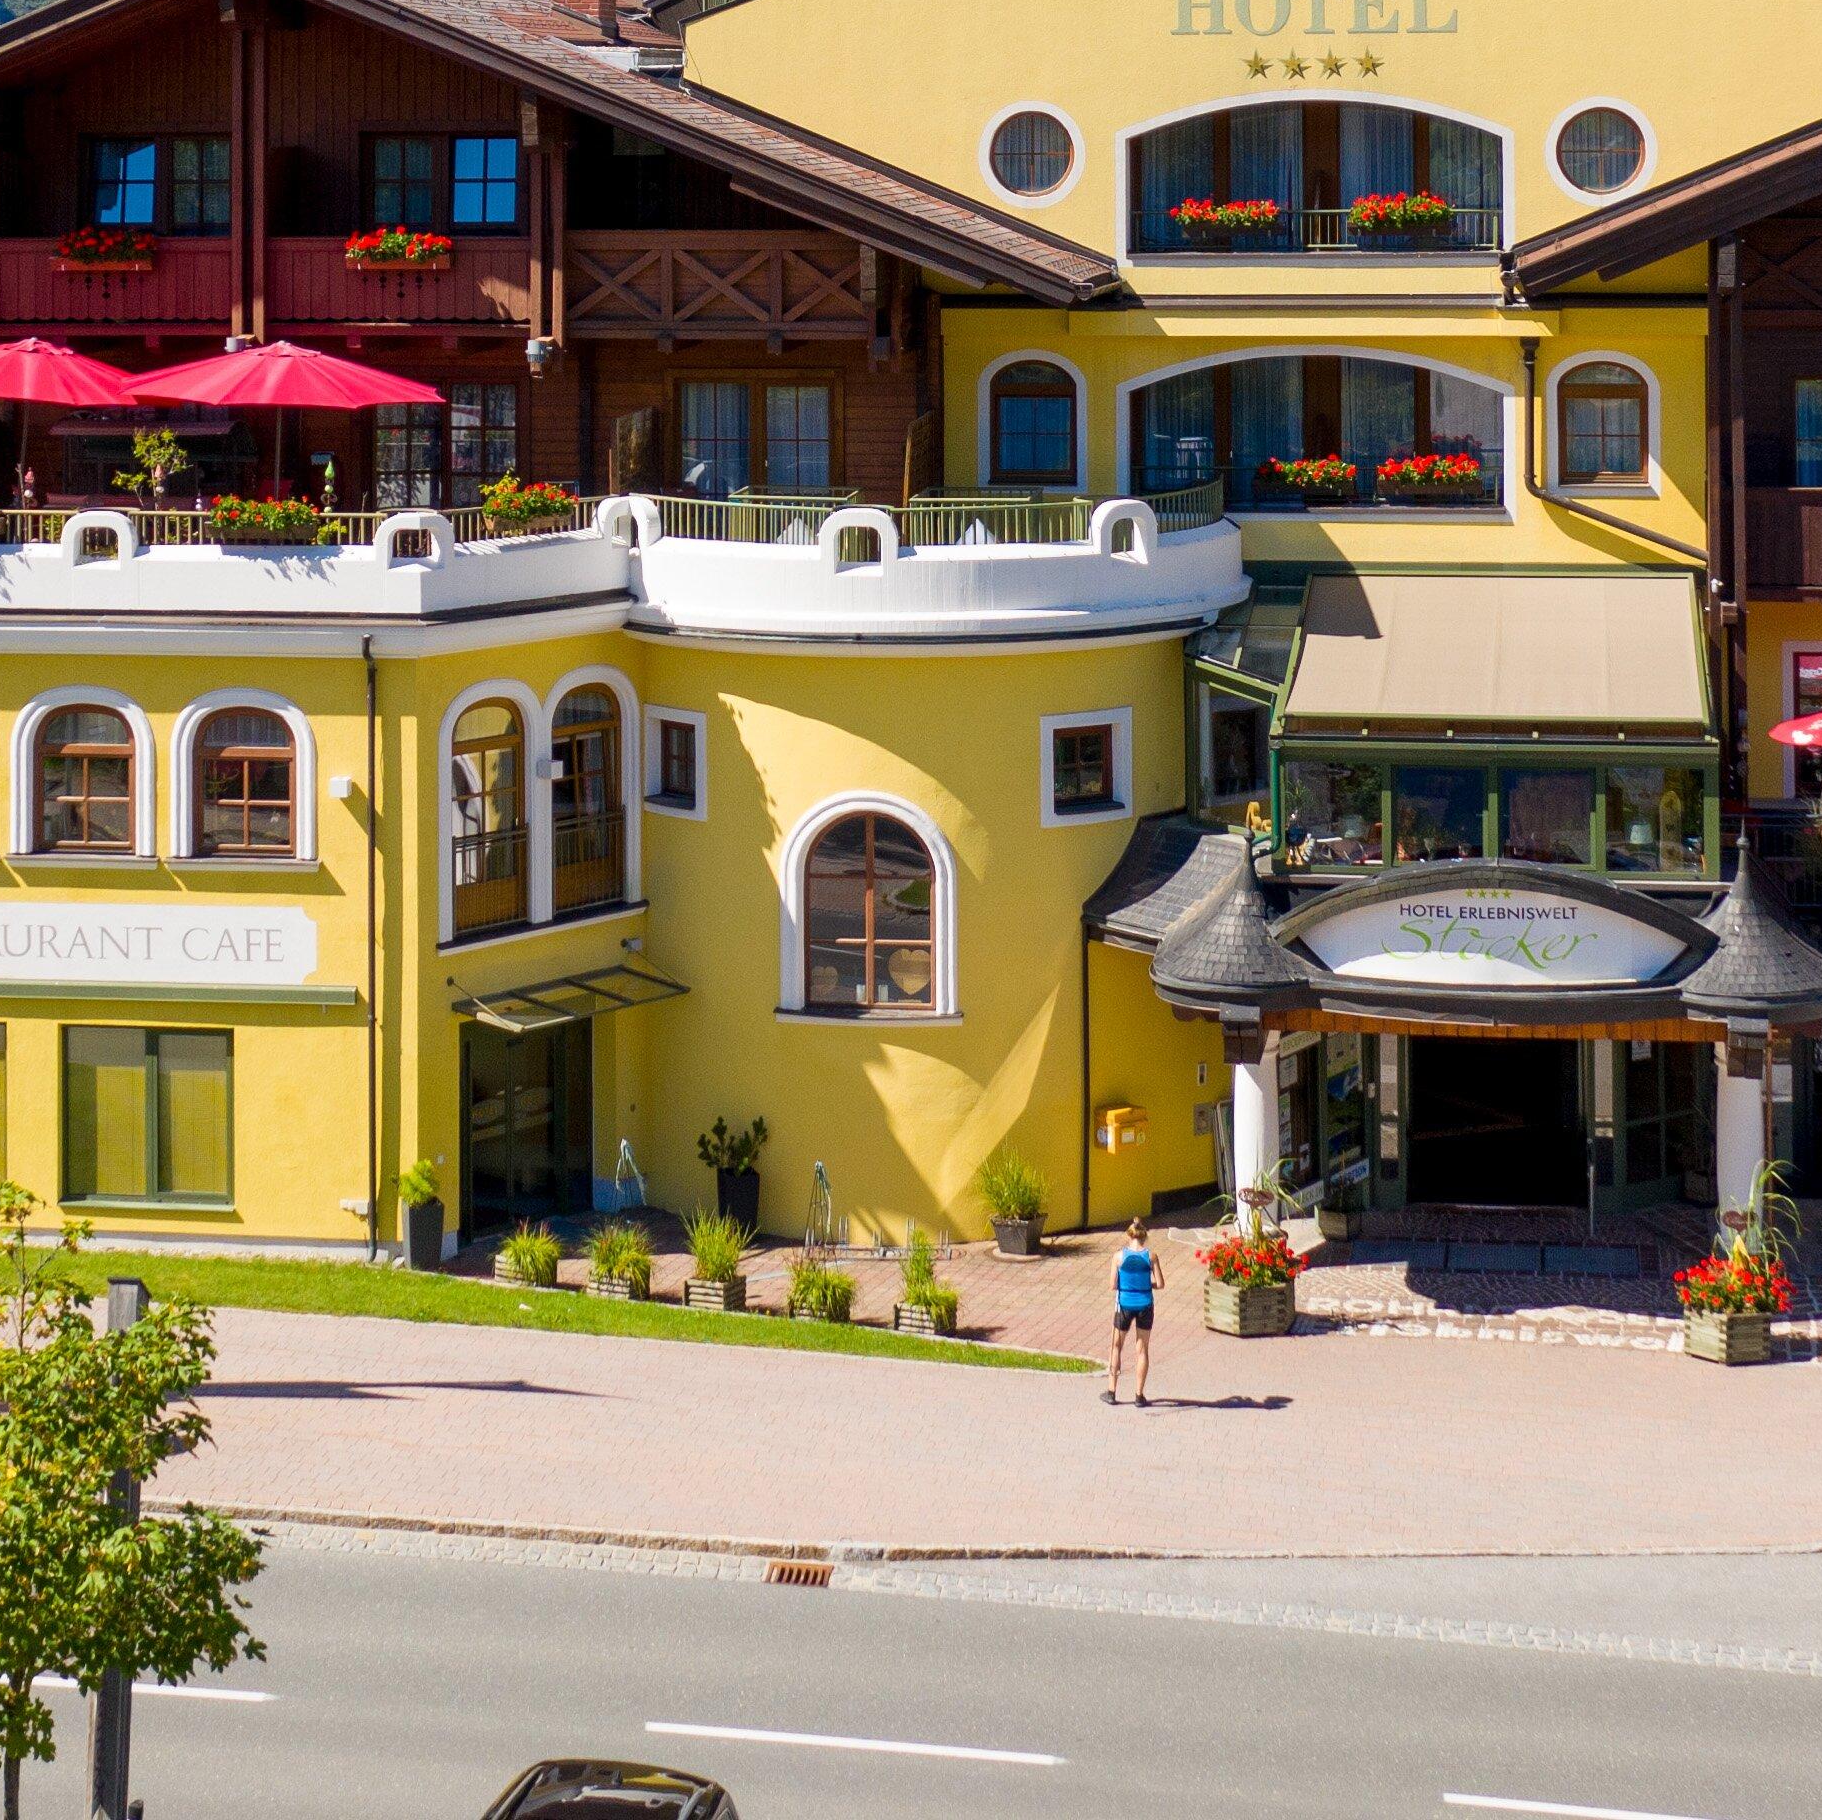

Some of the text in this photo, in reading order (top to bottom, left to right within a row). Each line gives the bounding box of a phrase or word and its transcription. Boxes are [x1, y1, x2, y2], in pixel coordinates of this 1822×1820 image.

[1399, 903, 1579, 921] HOTEL ERLEBNISWELT
[181, 926, 286, 963] CAFE
